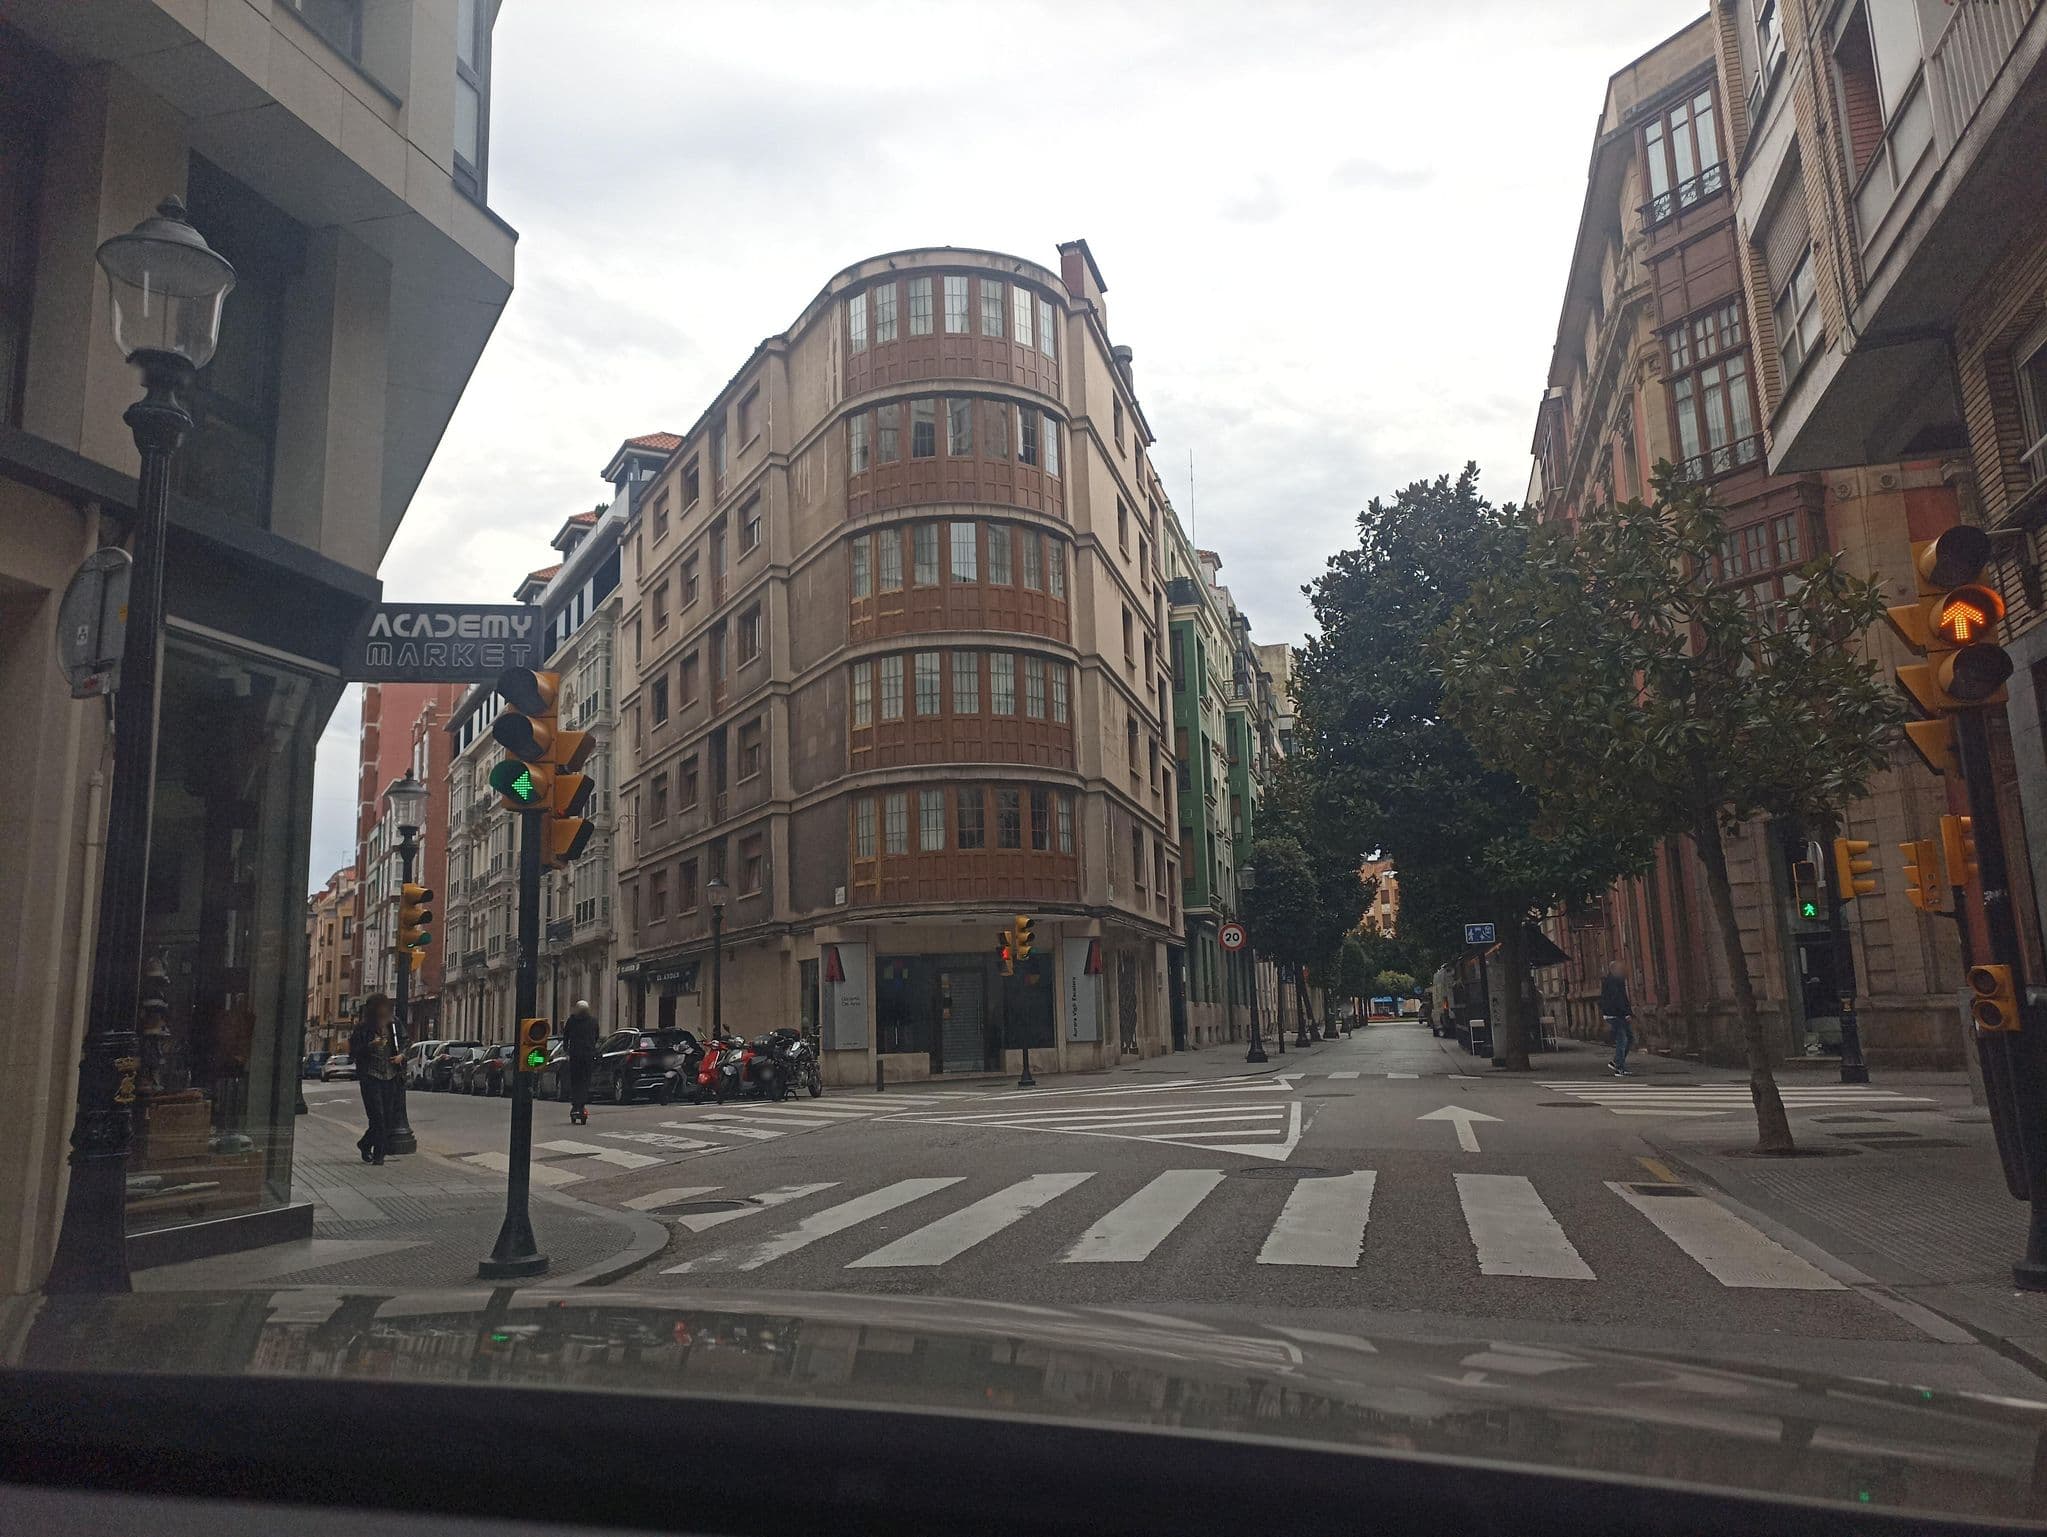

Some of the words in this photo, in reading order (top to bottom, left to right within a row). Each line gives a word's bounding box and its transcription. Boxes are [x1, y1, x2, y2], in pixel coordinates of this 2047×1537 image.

[368, 613, 532, 638] ACADEMY
[366, 642, 531, 667] MARKET
[1225, 933, 1240, 942] 20
